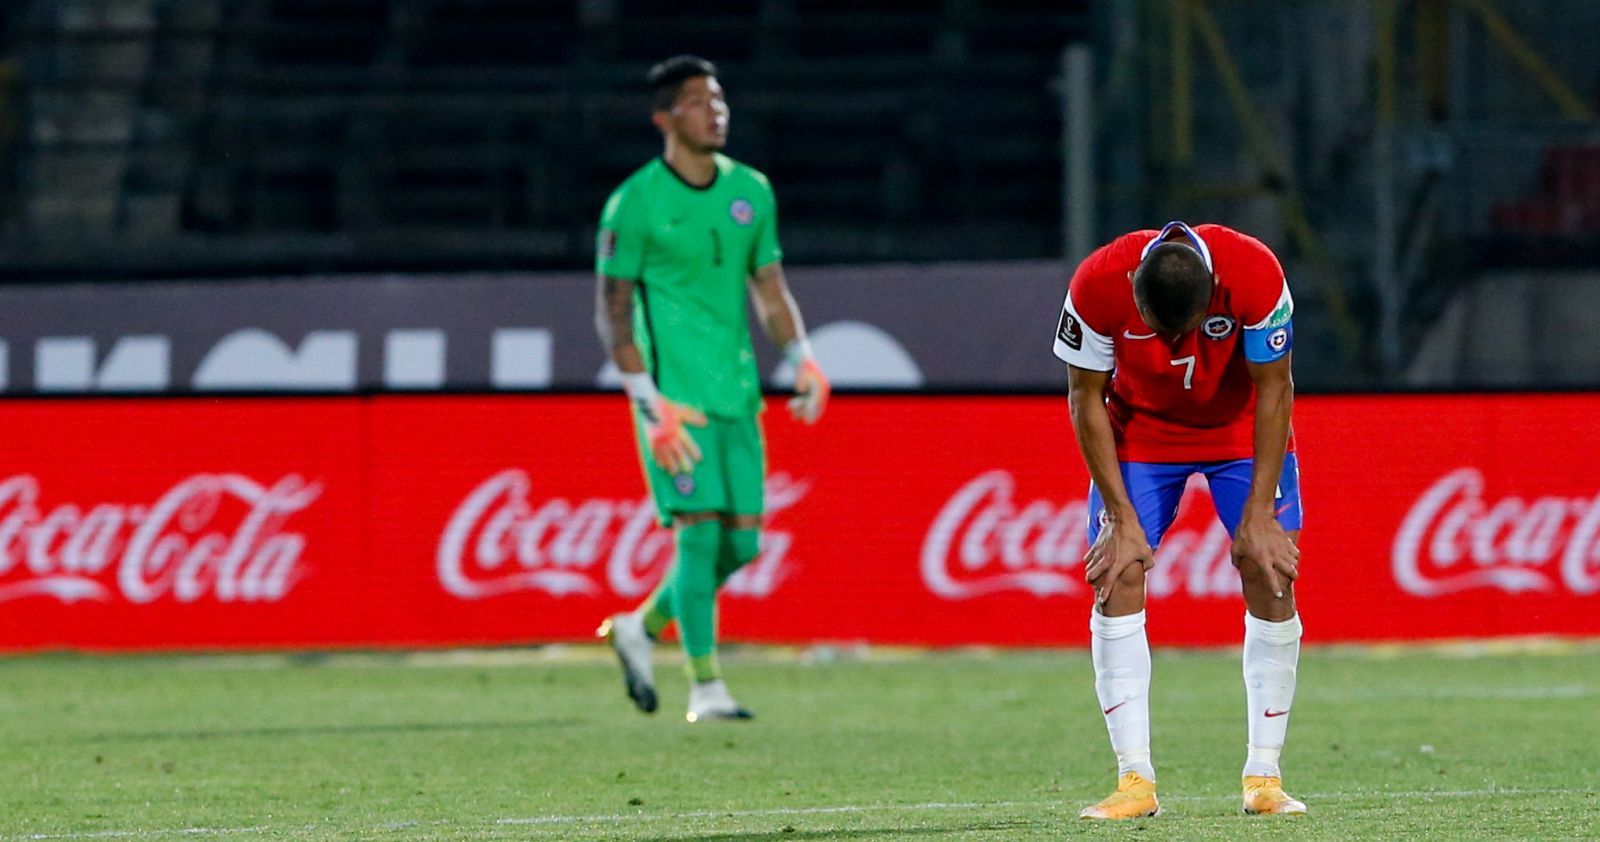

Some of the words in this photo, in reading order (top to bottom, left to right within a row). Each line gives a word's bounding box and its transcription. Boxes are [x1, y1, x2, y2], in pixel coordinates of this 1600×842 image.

[710, 227, 723, 267] 1
[1170, 355, 1196, 390] 7
[436, 469, 814, 598] Coca-Ca
